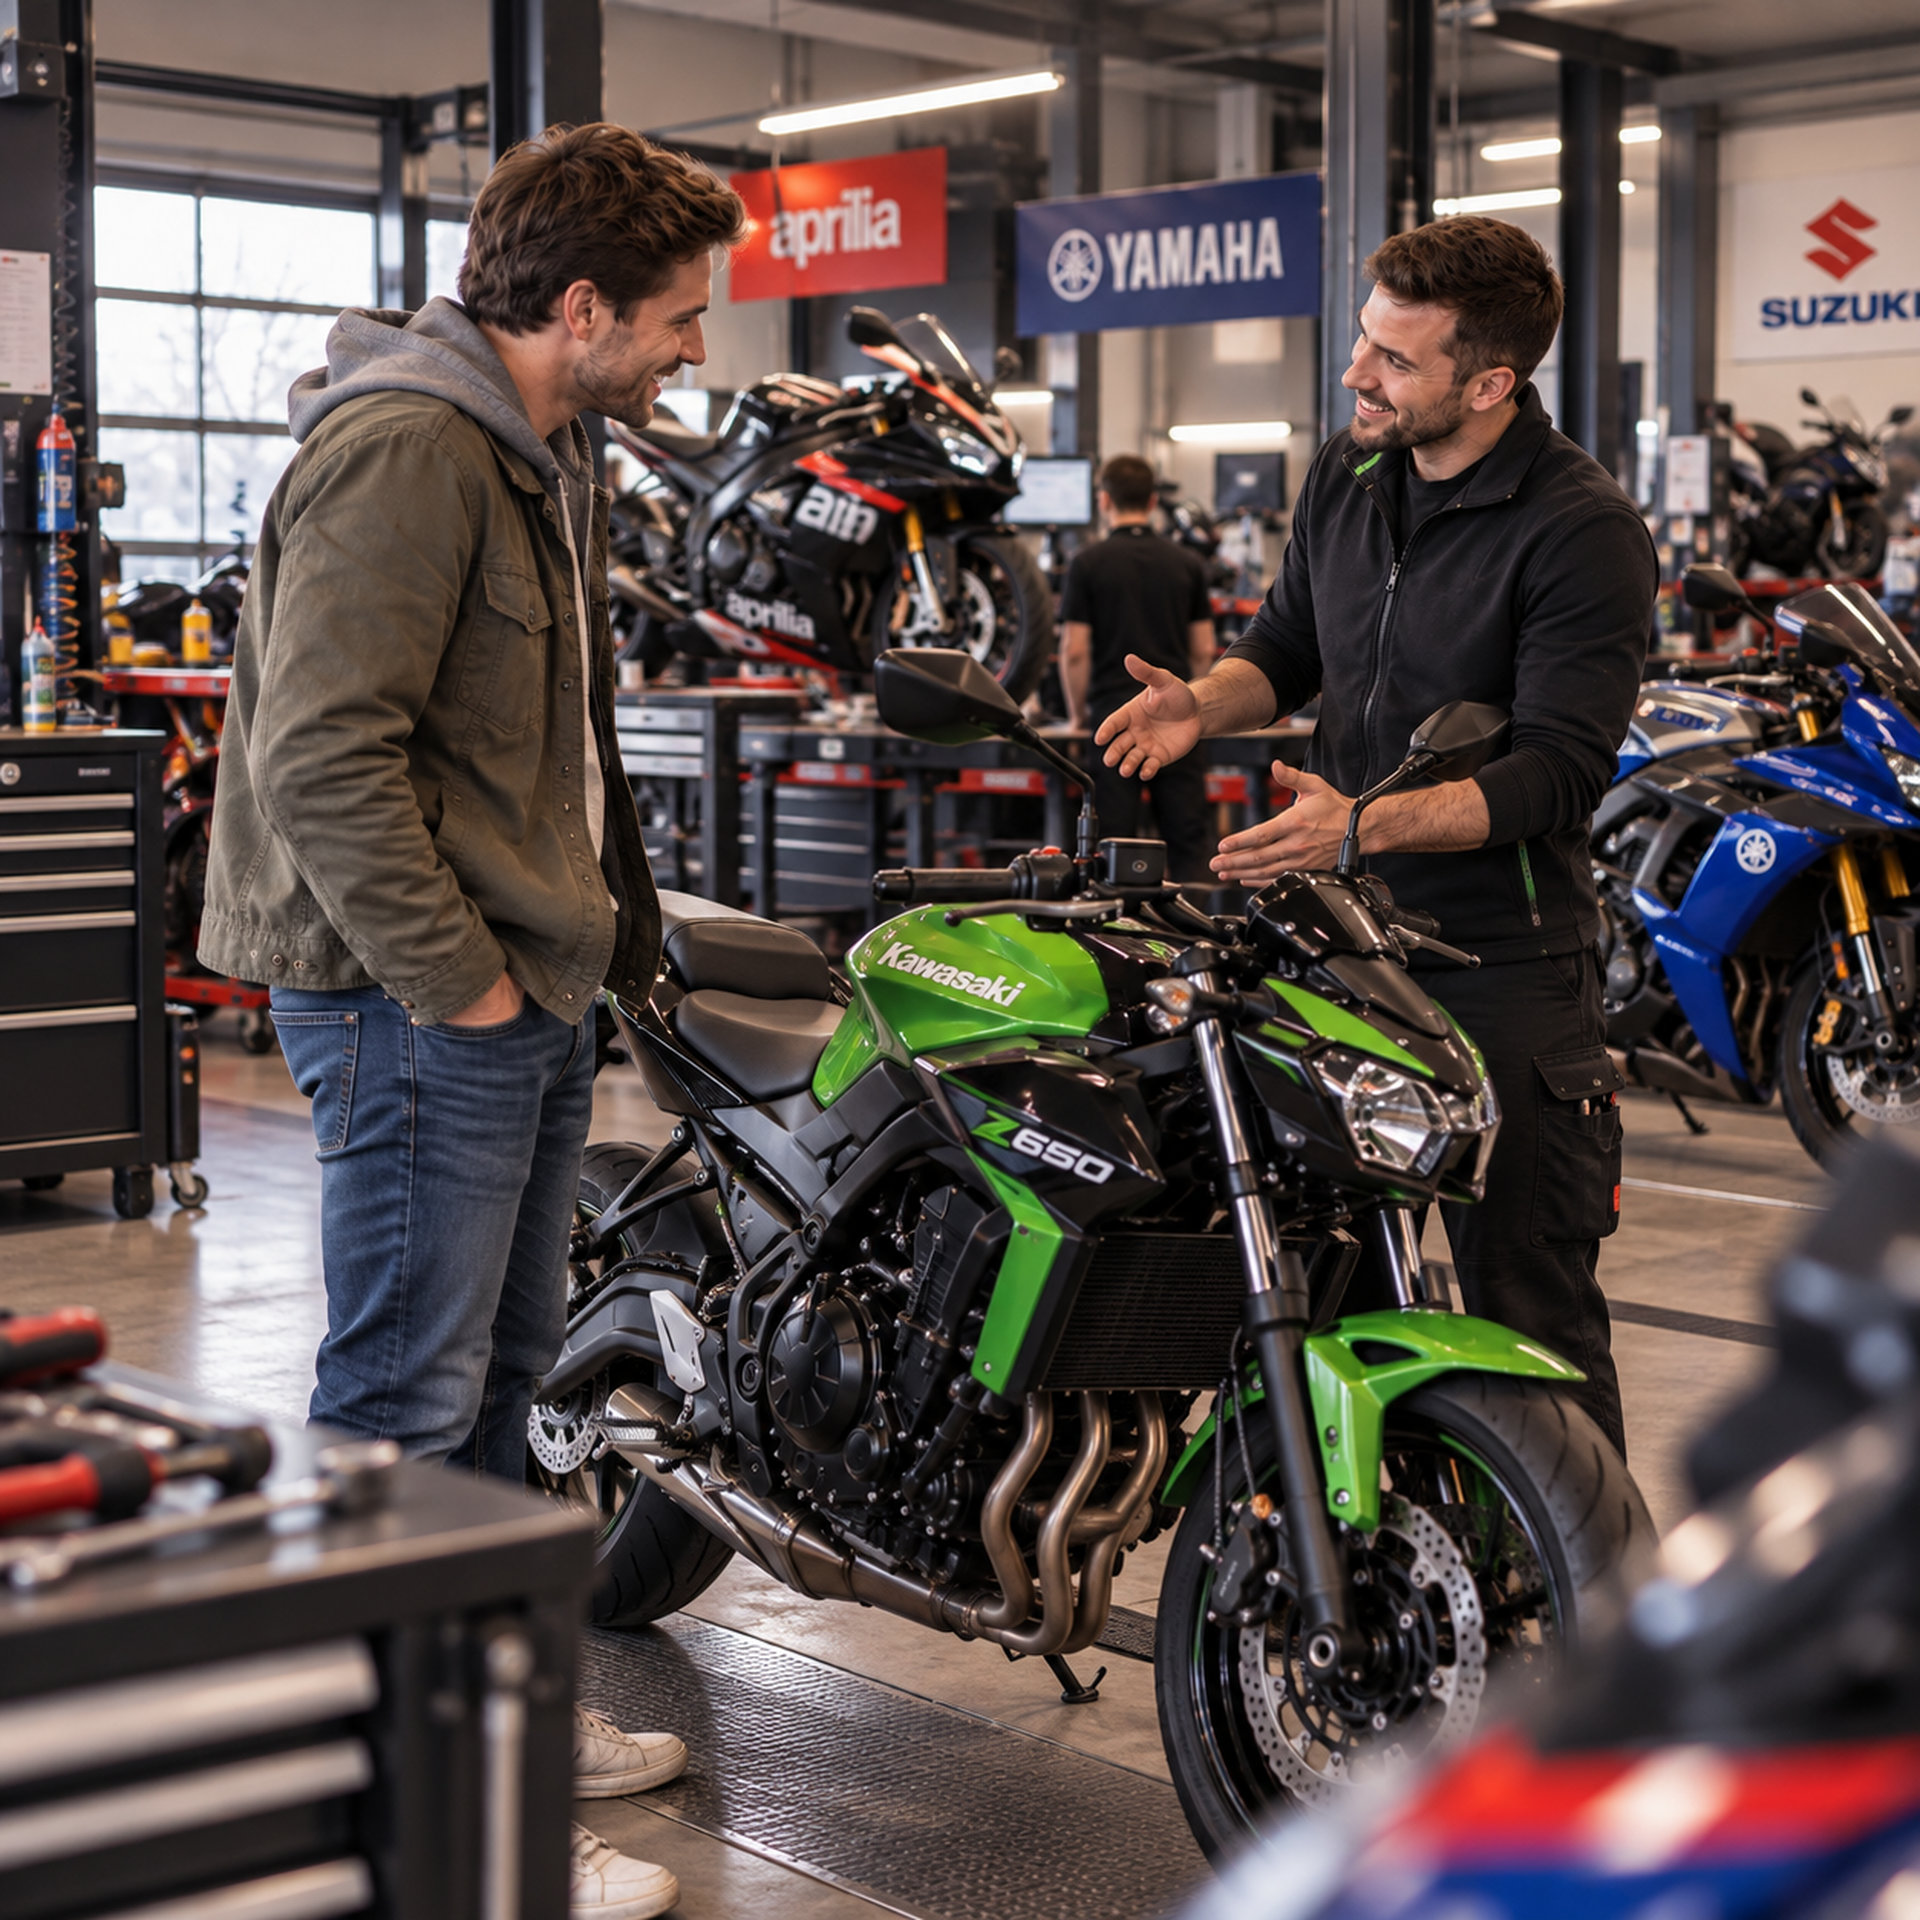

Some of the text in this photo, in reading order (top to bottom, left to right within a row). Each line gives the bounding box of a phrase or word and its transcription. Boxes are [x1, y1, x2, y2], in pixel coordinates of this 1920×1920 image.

[769, 186, 902, 270] aprilia
[1105, 217, 1284, 292] YAMAHA
[1760, 290, 1920, 330] SUZUKI
[726, 592, 816, 640] aprilia
[876, 941, 1027, 1007] Kawasaki
[970, 1109, 1116, 1185] Z650
